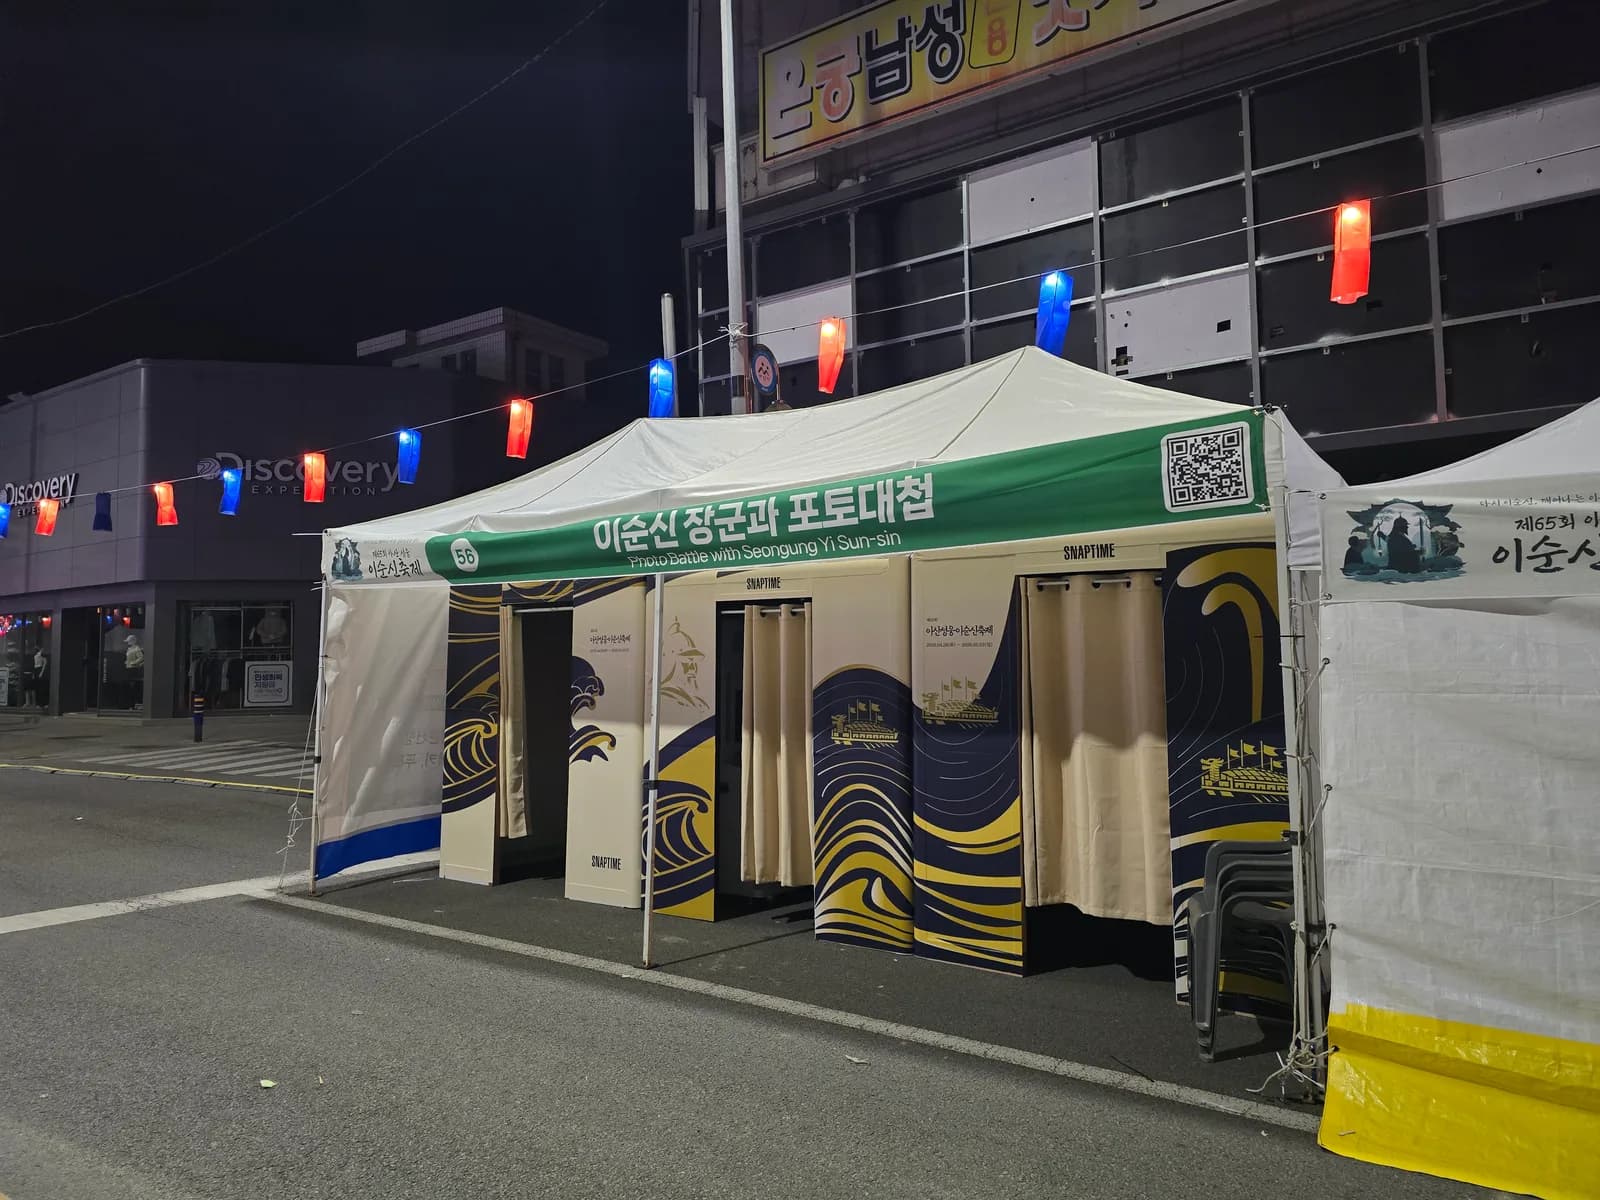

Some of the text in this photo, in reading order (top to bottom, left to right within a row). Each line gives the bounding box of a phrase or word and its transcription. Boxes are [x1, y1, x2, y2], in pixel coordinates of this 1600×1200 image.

[216, 452, 399, 492] Discvery
[251, 486, 377, 496] EXPETION
[593, 472, 935, 553] 이순신 장군과 포토대첩
[1514, 512, 1575, 532] 제65회
[455, 548, 475, 565] 56
[627, 531, 902, 569] Photo Battle with Seongung Yi Sun-sin
[1063, 543, 1115, 560] SNAPTIME
[368, 557, 424, 578] 이순신축제
[746, 576, 781, 590] SNAPTIME
[591, 855, 622, 871] SNAPTIME
